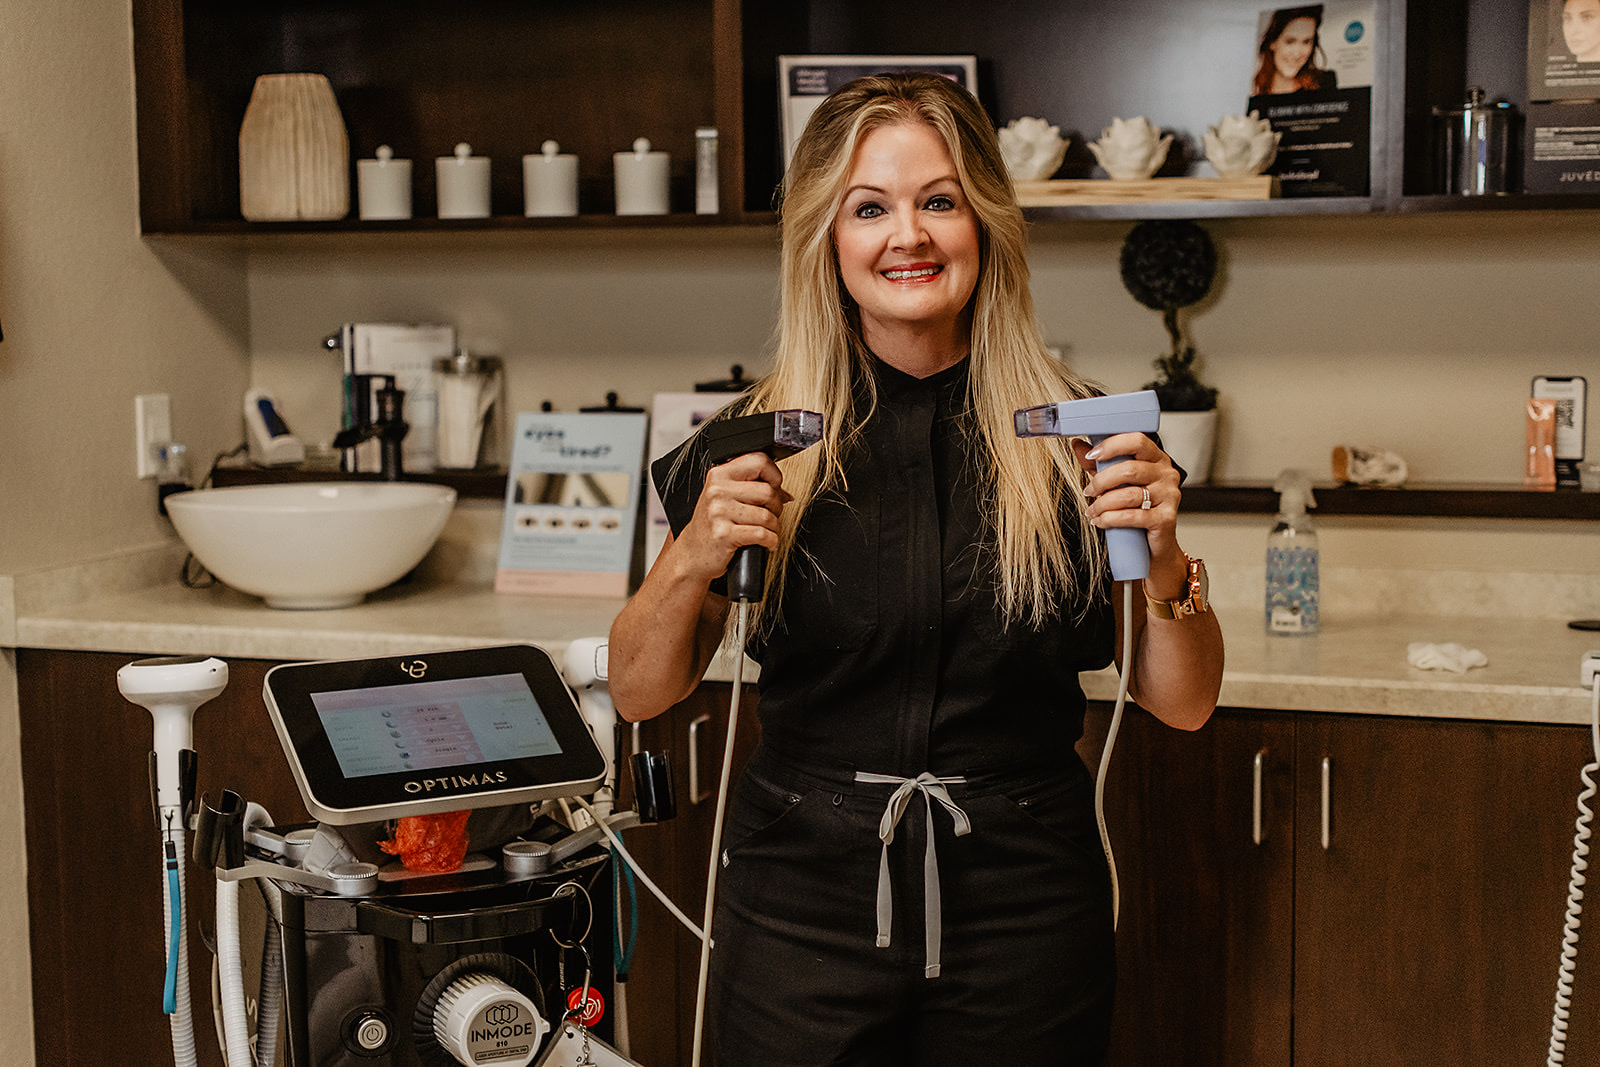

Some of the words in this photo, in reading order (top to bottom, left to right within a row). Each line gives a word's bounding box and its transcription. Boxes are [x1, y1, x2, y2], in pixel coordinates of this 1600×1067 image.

[524, 428, 565, 442] eyes
[559, 445, 611, 459] tired?
[404, 771, 508, 793] OPTIMAS
[471, 1022, 533, 1043] INMODE
